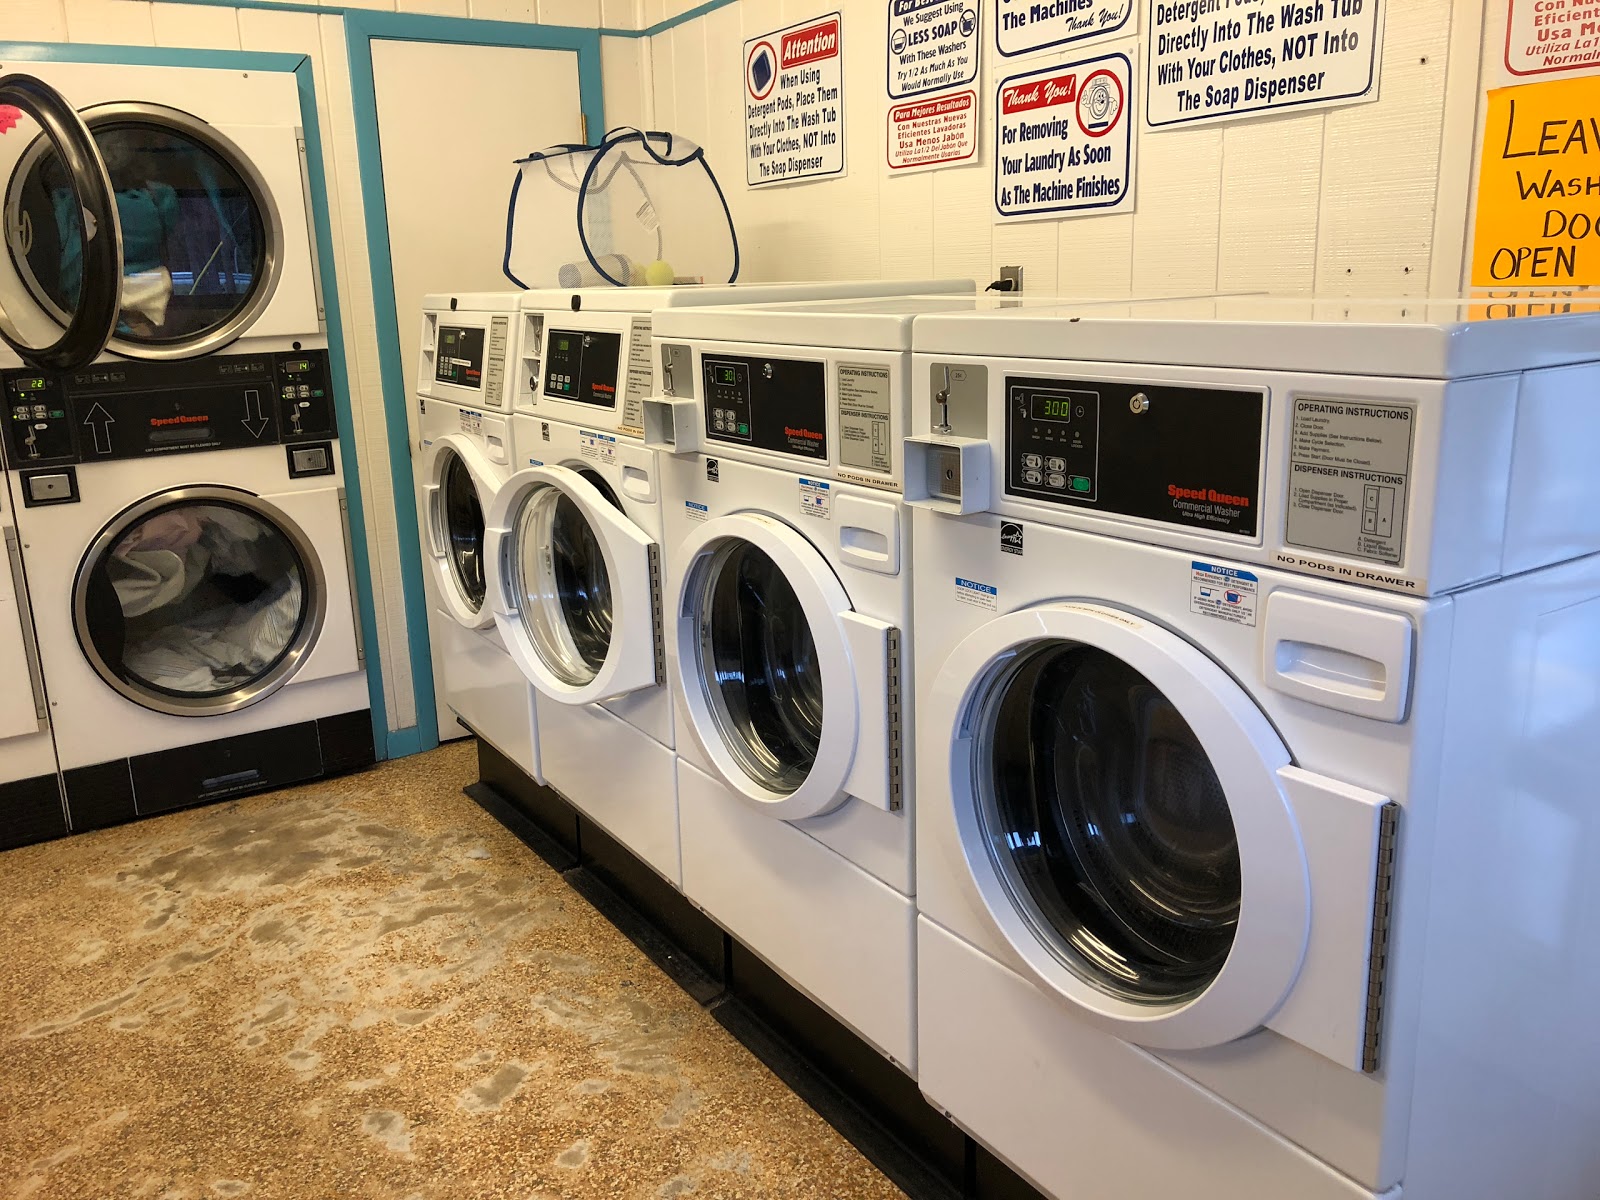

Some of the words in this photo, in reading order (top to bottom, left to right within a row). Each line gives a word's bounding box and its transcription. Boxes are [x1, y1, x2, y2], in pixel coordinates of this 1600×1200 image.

[899, 0, 913, 13] For
[903, 16, 913, 26] We
[916, 8, 942, 23] Suggest
[945, 2, 964, 15] Using
[1003, 12, 1026, 30] The
[1030, 0, 1093, 24] Machines
[1157, 0, 1220, 26] Detergent
[1535, 0, 1565, 12] Con
[1066, 12, 1095, 32] Thank
[1099, 4, 1124, 27] You!
[1158, 26, 1208, 56] Directly
[1213, 19, 1241, 43] Into
[1247, 12, 1274, 35] The
[1281, 2, 1323, 29] Wash
[1332, 0, 1362, 19] Tub
[909, 29, 929, 46] LESS
[932, 21, 957, 40] SOAP
[1538, 28, 1572, 41] Usa
[784, 32, 835, 61] Attention
[900, 53, 915, 65] With
[917, 49, 936, 61] These
[938, 41, 967, 55] Washers
[1158, 62, 1183, 86] With
[1188, 56, 1215, 79] Your
[1219, 47, 1276, 73] Clothes,
[1282, 34, 1318, 62] NOT
[1324, 28, 1359, 55] Into
[1526, 43, 1570, 56] Utiliza
[780, 74, 798, 89] When
[800, 68, 820, 85] Using
[898, 71, 907, 81] Try
[909, 68, 919, 77] 1/2
[921, 66, 928, 75] As
[930, 61, 946, 73] Much
[947, 59, 955, 68] As
[957, 56, 968, 66] You
[901, 79, 921, 92] Would
[922, 73, 952, 88] Normally
[953, 70, 964, 80] Use
[1004, 85, 1040, 108] Thank
[1044, 77, 1075, 105] You!
[1178, 90, 1200, 112] The
[1205, 85, 1239, 109] Soap
[1244, 71, 1325, 104] Dispenser
[748, 99, 776, 119] Detergent
[777, 95, 794, 111] Pods,
[796, 91, 815, 107] Place
[817, 87, 838, 102] Them
[895, 111, 911, 120] Para
[911, 105, 935, 118] Mejores
[936, 98, 969, 112] Resultados
[749, 121, 771, 139] Directly
[773, 119, 785, 133] Into
[787, 114, 799, 130] The
[801, 110, 819, 127] Wash
[822, 107, 836, 123] Tub
[897, 123, 910, 131] Con
[912, 118, 941, 128] Nuestras
[944, 113, 967, 123] Nuevas
[898, 129, 931, 140] Eficientes
[933, 122, 966, 133] Lavadoras
[1002, 126, 1017, 145] For
[1020, 116, 1068, 142] Removing
[750, 144, 761, 159] With
[763, 142, 775, 156] Your
[777, 137, 801, 153] Clothes,
[803, 131, 818, 149] NOT
[821, 130, 836, 145] Into
[900, 141, 913, 149] Usa
[916, 136, 940, 147] Menos
[760, 163, 770, 177] The
[771, 161, 787, 177] Soap
[788, 156, 823, 174] Dispenser
[1002, 156, 1022, 176] Your
[1025, 149, 1065, 173] Laundry
[1068, 146, 1081, 167] As
[1084, 144, 1111, 165] Soon
[1001, 187, 1012, 206] As
[1014, 185, 1030, 205] The
[1033, 179, 1073, 202] Machine
[1076, 175, 1120, 198] Finishes
[1489, 245, 1576, 280] OPEN
[31, 380, 43, 388] 22
[151, 417, 179, 426] Speed
[180, 415, 209, 423] Queen
[1298, 403, 1344, 415] OPERATING
[1346, 408, 1409, 420] INSTRUCTIONS
[785, 426, 803, 436] Speed
[803, 429, 823, 440] Queen
[1295, 465, 1339, 477] DISPENSER
[1340, 470, 1403, 485] INSTRUCTIONS
[1168, 484, 1207, 499] Speed
[1208, 490, 1249, 507] Queen
[1173, 499, 1213, 514] Commercial
[1214, 505, 1240, 518] Washer
[1211, 566, 1238, 576] NOTICE
[1277, 555, 1296, 564] NO
[1299, 559, 1335, 572] PODS
[1339, 567, 1352, 576] IN
[1356, 571, 1416, 589] DRAWER
[961, 580, 991, 593] NOTICE
